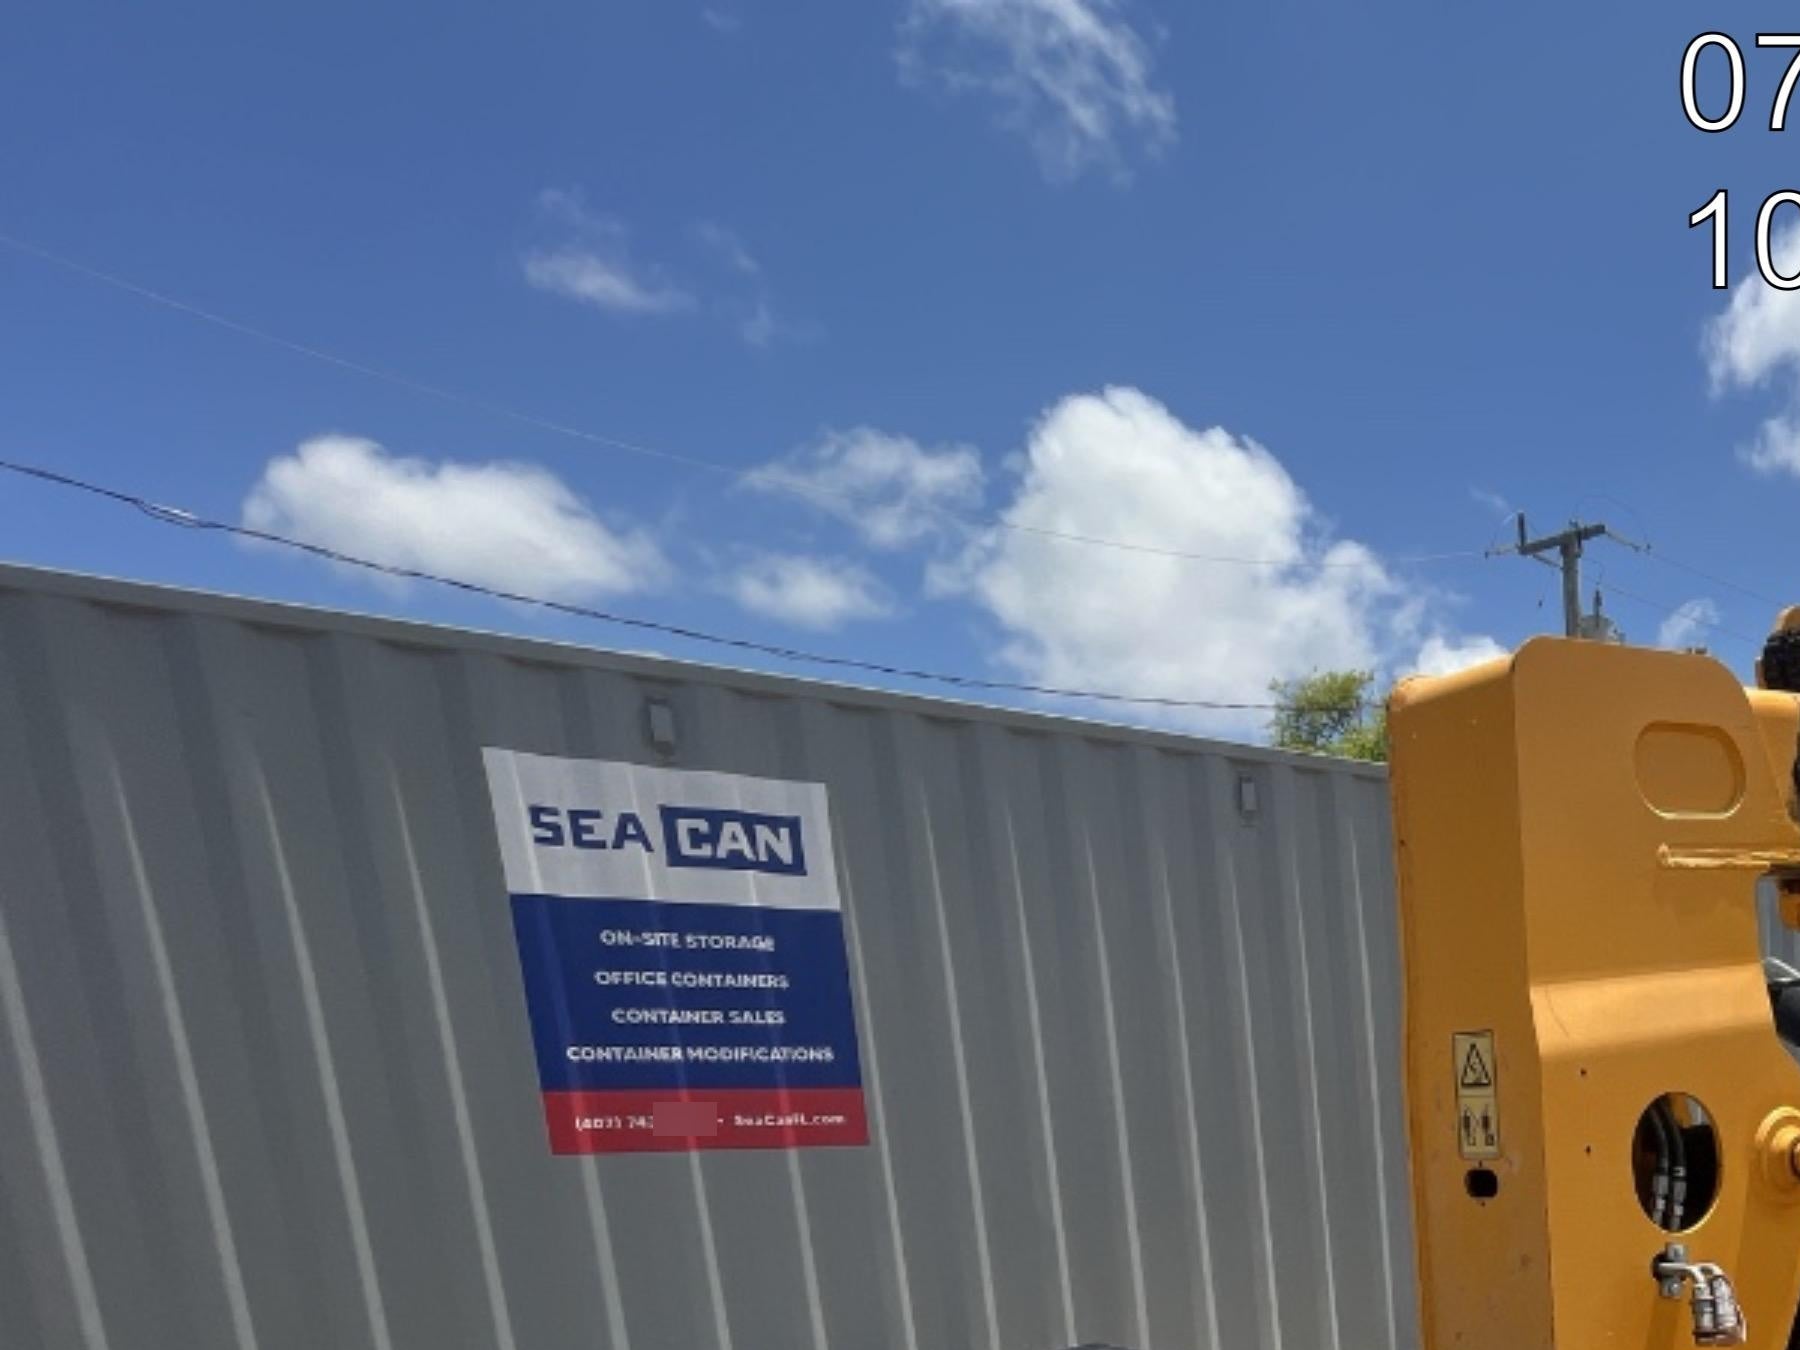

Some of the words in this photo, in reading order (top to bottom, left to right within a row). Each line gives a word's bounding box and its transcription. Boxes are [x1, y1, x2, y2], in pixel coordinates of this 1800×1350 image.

[528, 804, 654, 853] SEA
[675, 817, 794, 866] CAN
[599, 929, 681, 949] ON-SITE
[685, 934, 776, 952] STORAGE
[594, 970, 667, 986] OFFICE
[671, 974, 790, 990] CONTAINERS
[611, 1007, 724, 1025] CONTAINER
[728, 1010, 787, 1025] SALES
[566, 1045, 684, 1061] CONTAINER
[687, 1046, 835, 1062] MODIFICATIONS
